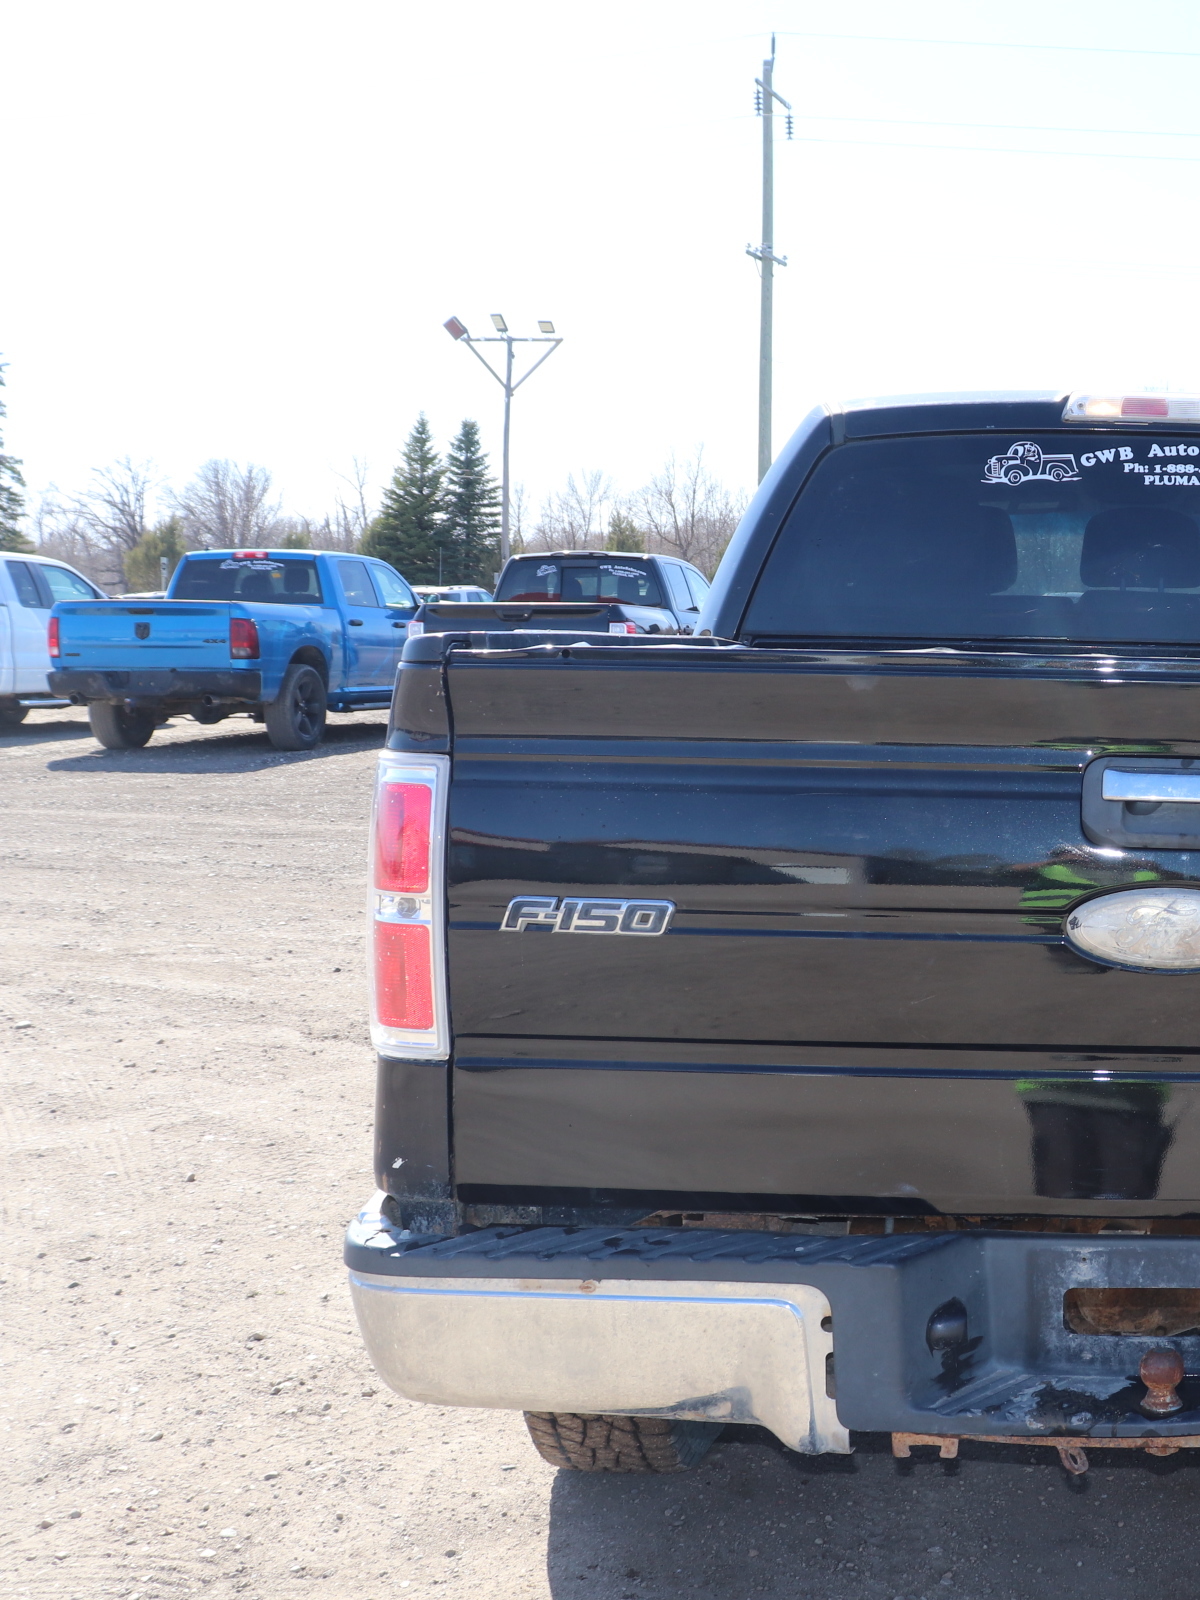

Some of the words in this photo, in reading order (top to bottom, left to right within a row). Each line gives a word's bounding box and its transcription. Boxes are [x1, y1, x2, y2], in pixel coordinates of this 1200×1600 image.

[1080, 446, 1134, 467] GWB
[1123, 462, 1149, 473] Ph:
[499, 895, 677, 937] F-150
